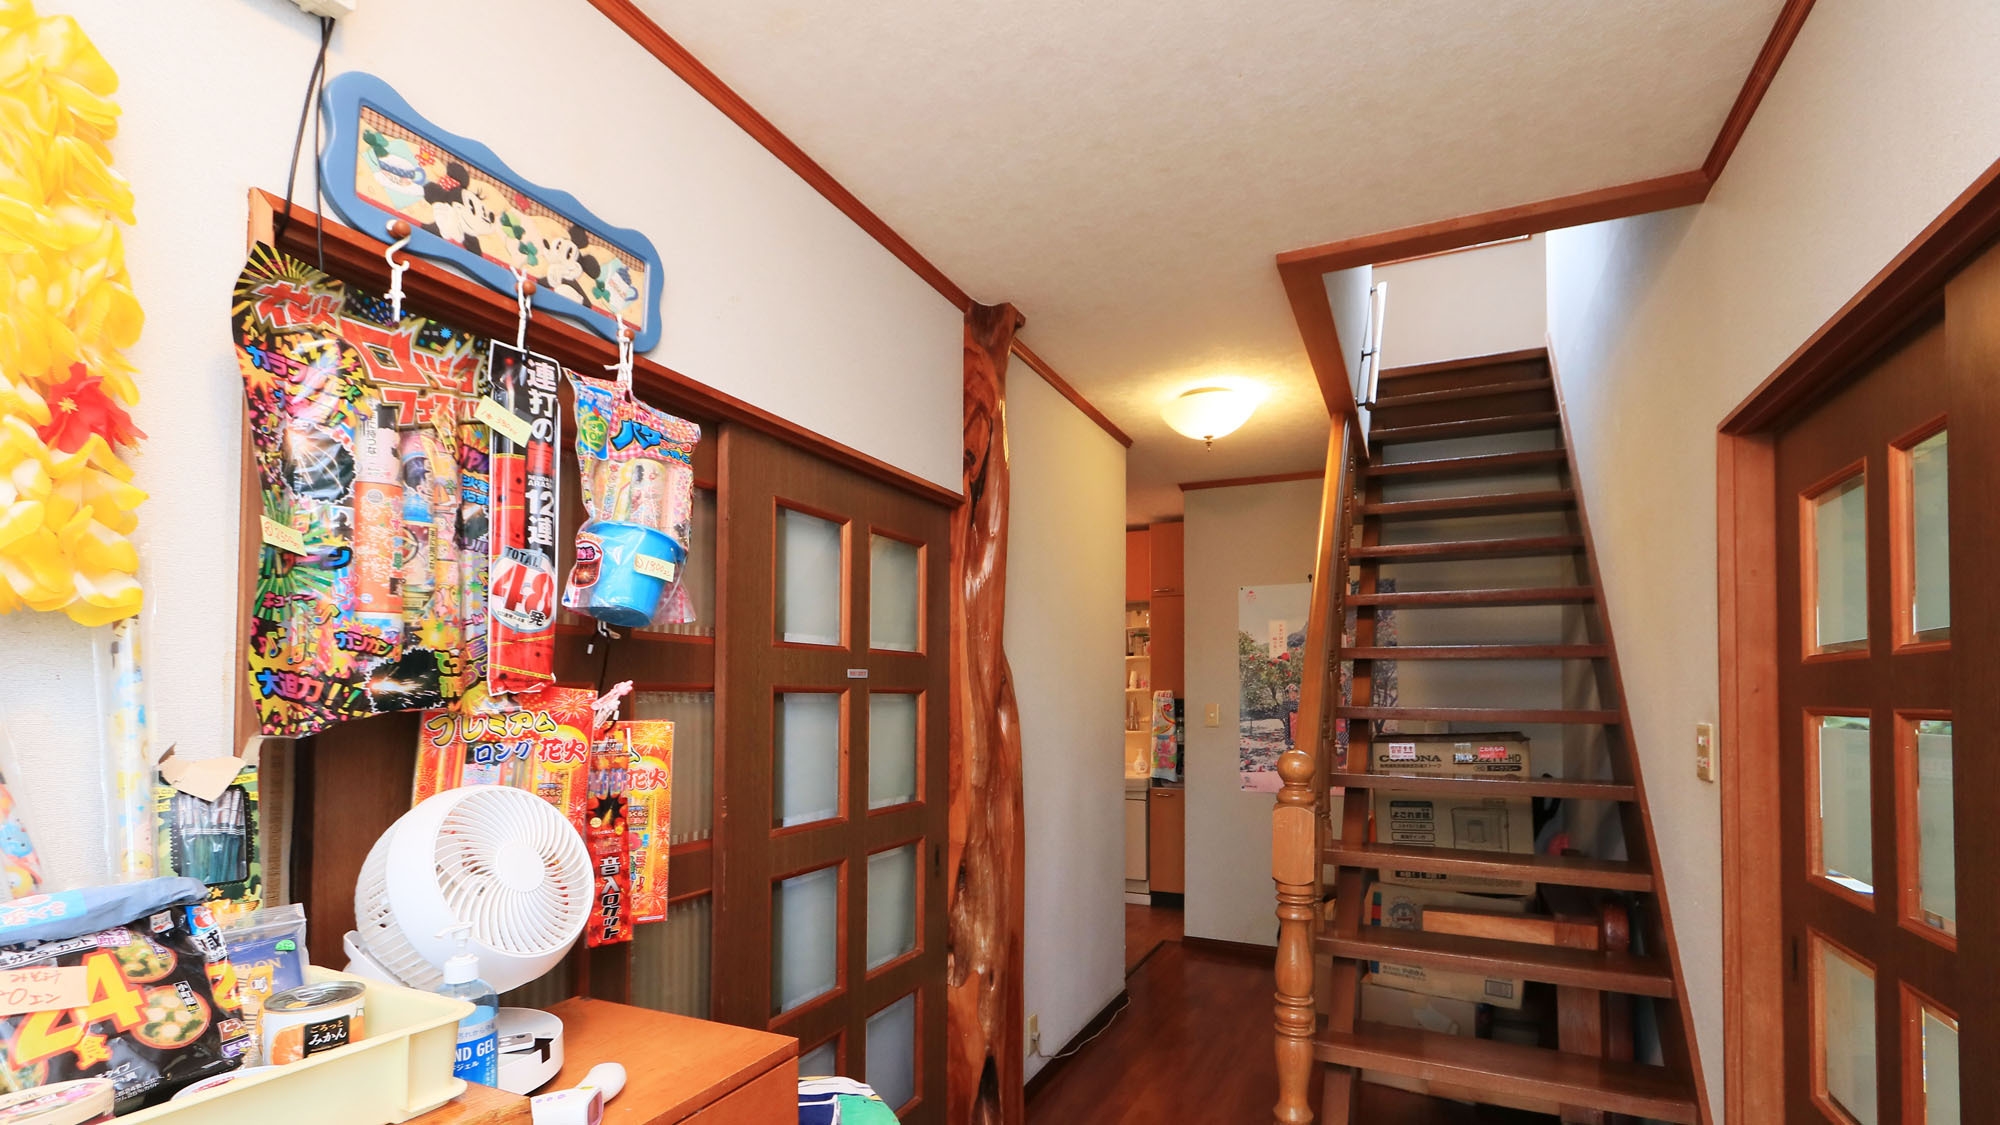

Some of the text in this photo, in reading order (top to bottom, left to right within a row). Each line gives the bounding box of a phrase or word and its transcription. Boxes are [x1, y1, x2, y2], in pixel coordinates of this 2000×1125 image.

[526, 358, 556, 443] 連打の
[526, 489, 554, 546] 12連
[505, 546, 539, 568] TOTAL
[427, 711, 557, 747] プレミアム
[538, 737, 587, 763] 花火
[1379, 754, 1442, 763] CNA
[627, 767, 668, 790] 花火
[600, 855, 621, 940] 音入ロケット
[308, 1028, 347, 1046] みかん
[310, 1020, 344, 1034] ごろっと
[455, 1038, 495, 1062] ND GEL
